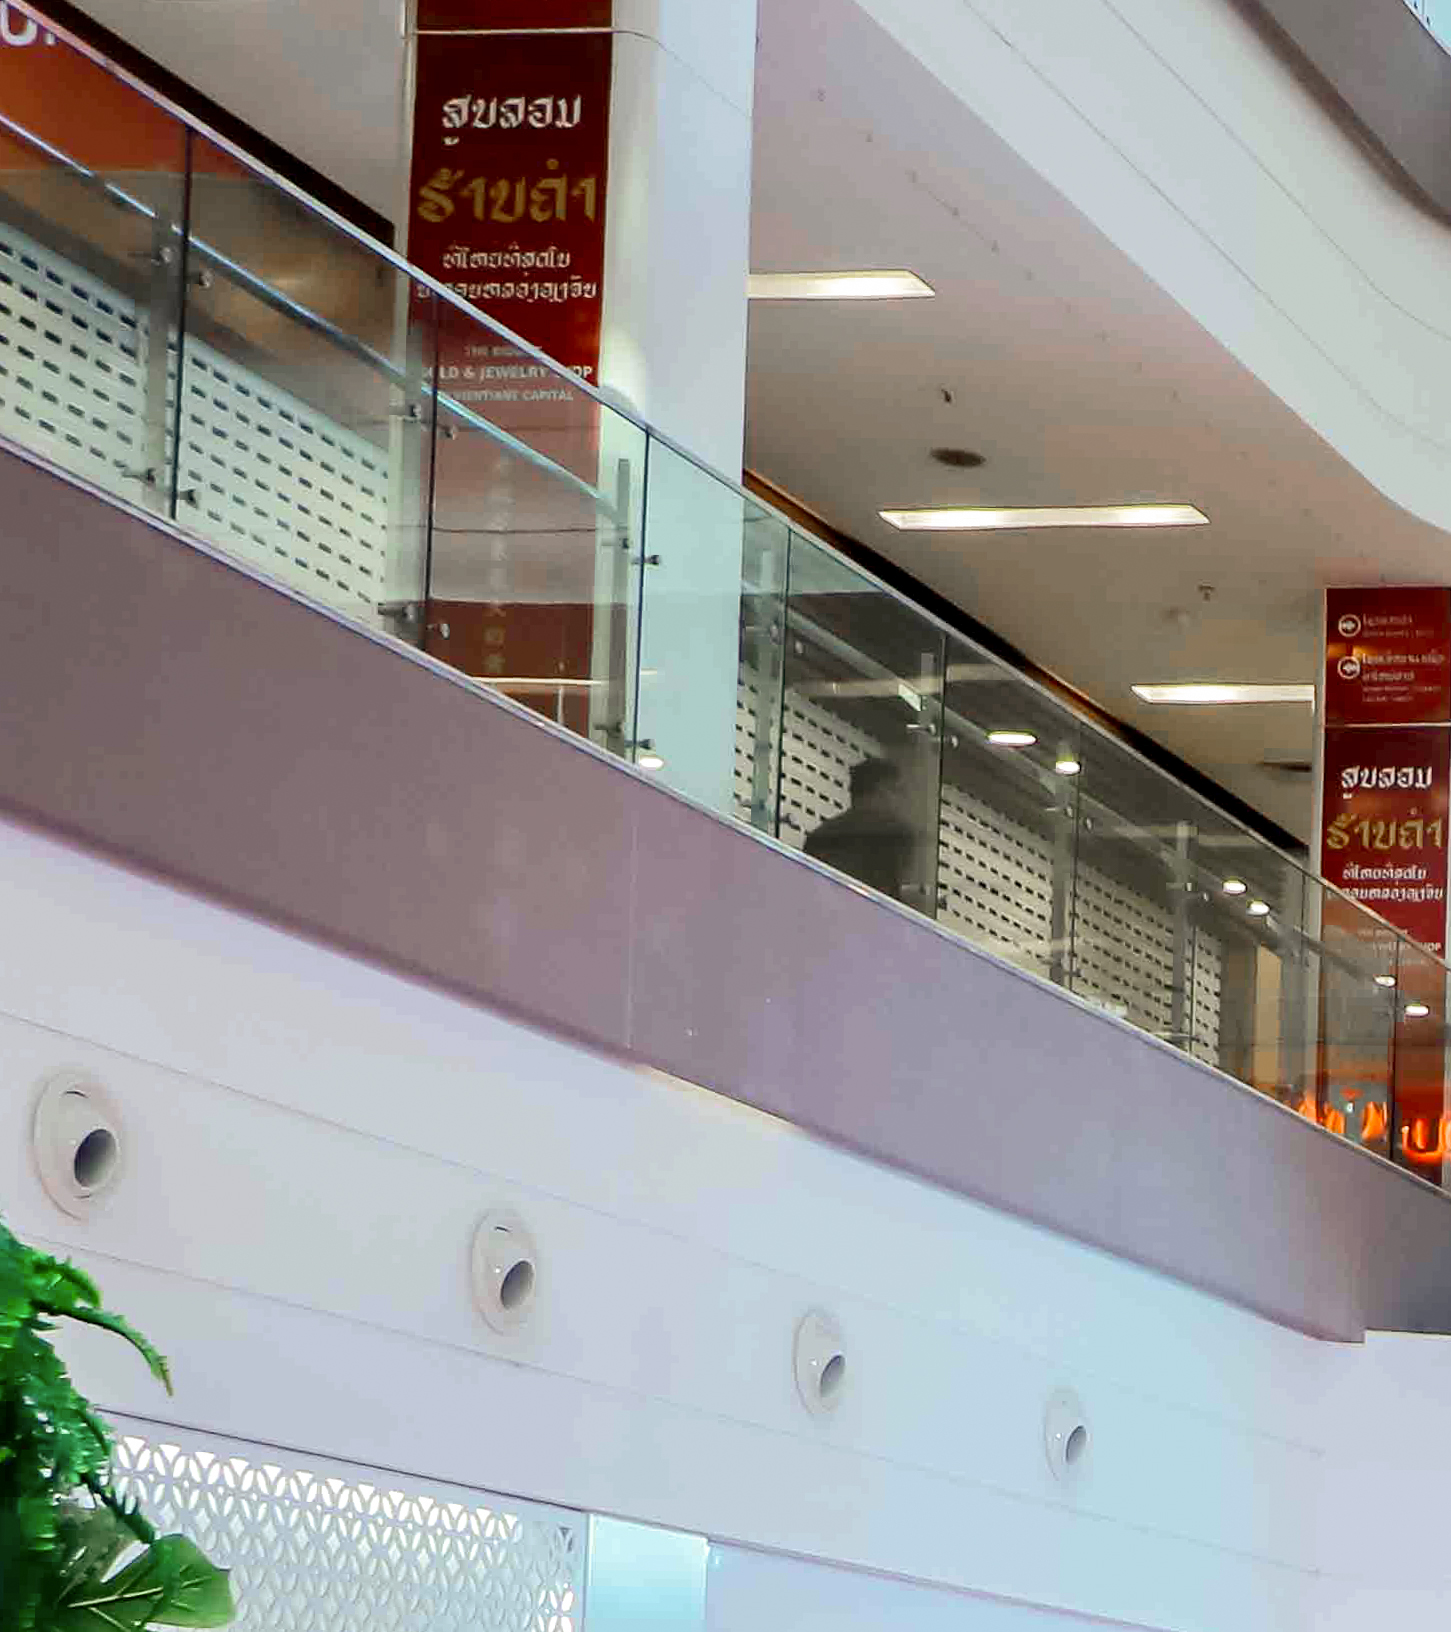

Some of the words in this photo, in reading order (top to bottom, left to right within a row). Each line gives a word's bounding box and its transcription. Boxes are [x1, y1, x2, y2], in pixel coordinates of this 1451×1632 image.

[416, 157, 598, 223] ຮ້ານຄຳ
[1326, 806, 1443, 850] ຮ້ານຄຳ
